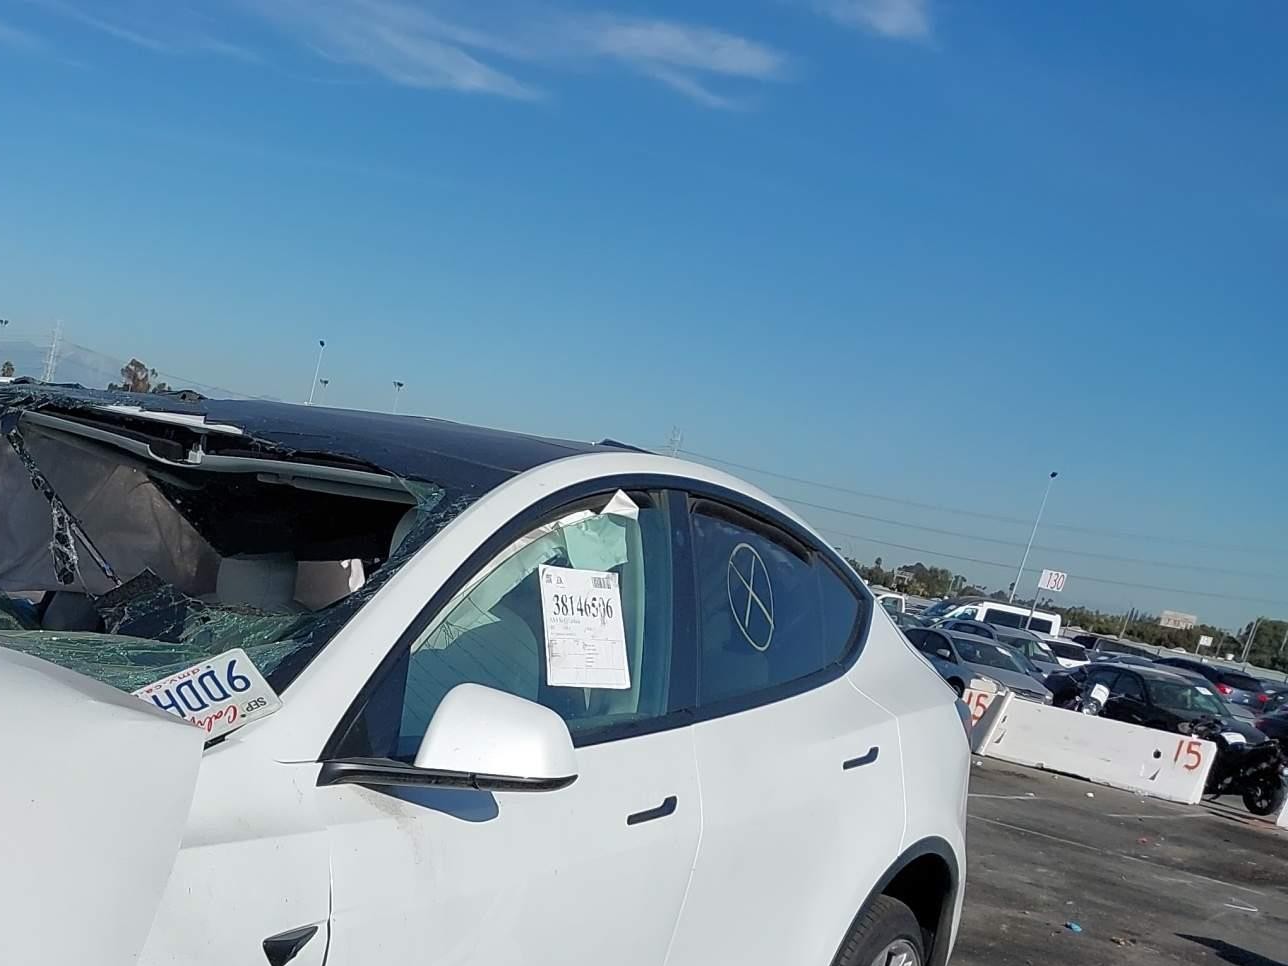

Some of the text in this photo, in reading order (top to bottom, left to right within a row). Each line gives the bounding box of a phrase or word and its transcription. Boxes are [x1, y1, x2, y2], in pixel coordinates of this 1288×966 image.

[1046, 572, 1065, 590] 130
[552, 594, 613, 618] 38146506
[246, 696, 267, 712] SEP
[1173, 739, 1202, 770] 15
